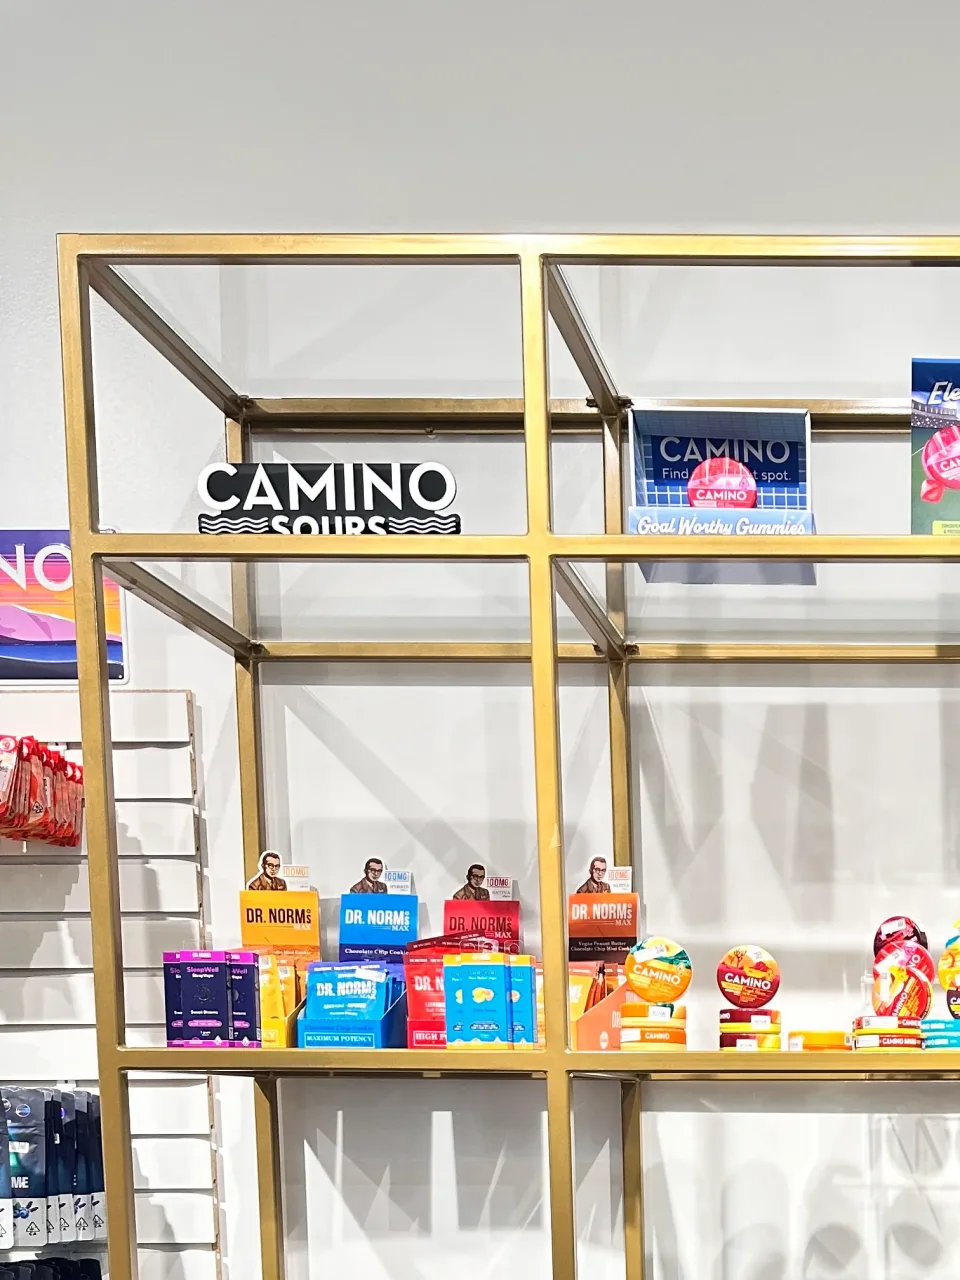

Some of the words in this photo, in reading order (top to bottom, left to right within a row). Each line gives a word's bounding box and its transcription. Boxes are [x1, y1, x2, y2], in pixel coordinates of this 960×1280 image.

[659, 436, 791, 464] CAMINO
[662, 467, 689, 480] Find
[761, 470, 792, 484] spot.
[198, 462, 457, 512] CAMINO
[696, 489, 748, 502] CAMINO
[271, 515, 388, 535] SOURS
[637, 516, 676, 535] Goal
[677, 517, 734, 535] Worthy
[735, 517, 806, 535] Gummies
[384, 872, 407, 881] 100MG
[486, 878, 509, 888] 100MG
[246, 907, 266, 924] DR.
[345, 908, 365, 925] DR.
[571, 903, 591, 921] DR.
[449, 915, 469, 931] DR.
[494, 931, 512, 939] MAX
[414, 975, 434, 991] DR.
[632, 964, 681, 986] CAMINO
[724, 972, 772, 990] CAMINO
[316, 982, 336, 997] DR.
[415, 1032, 437, 1040] HIGH
[645, 1032, 670, 1040] CAMINO
